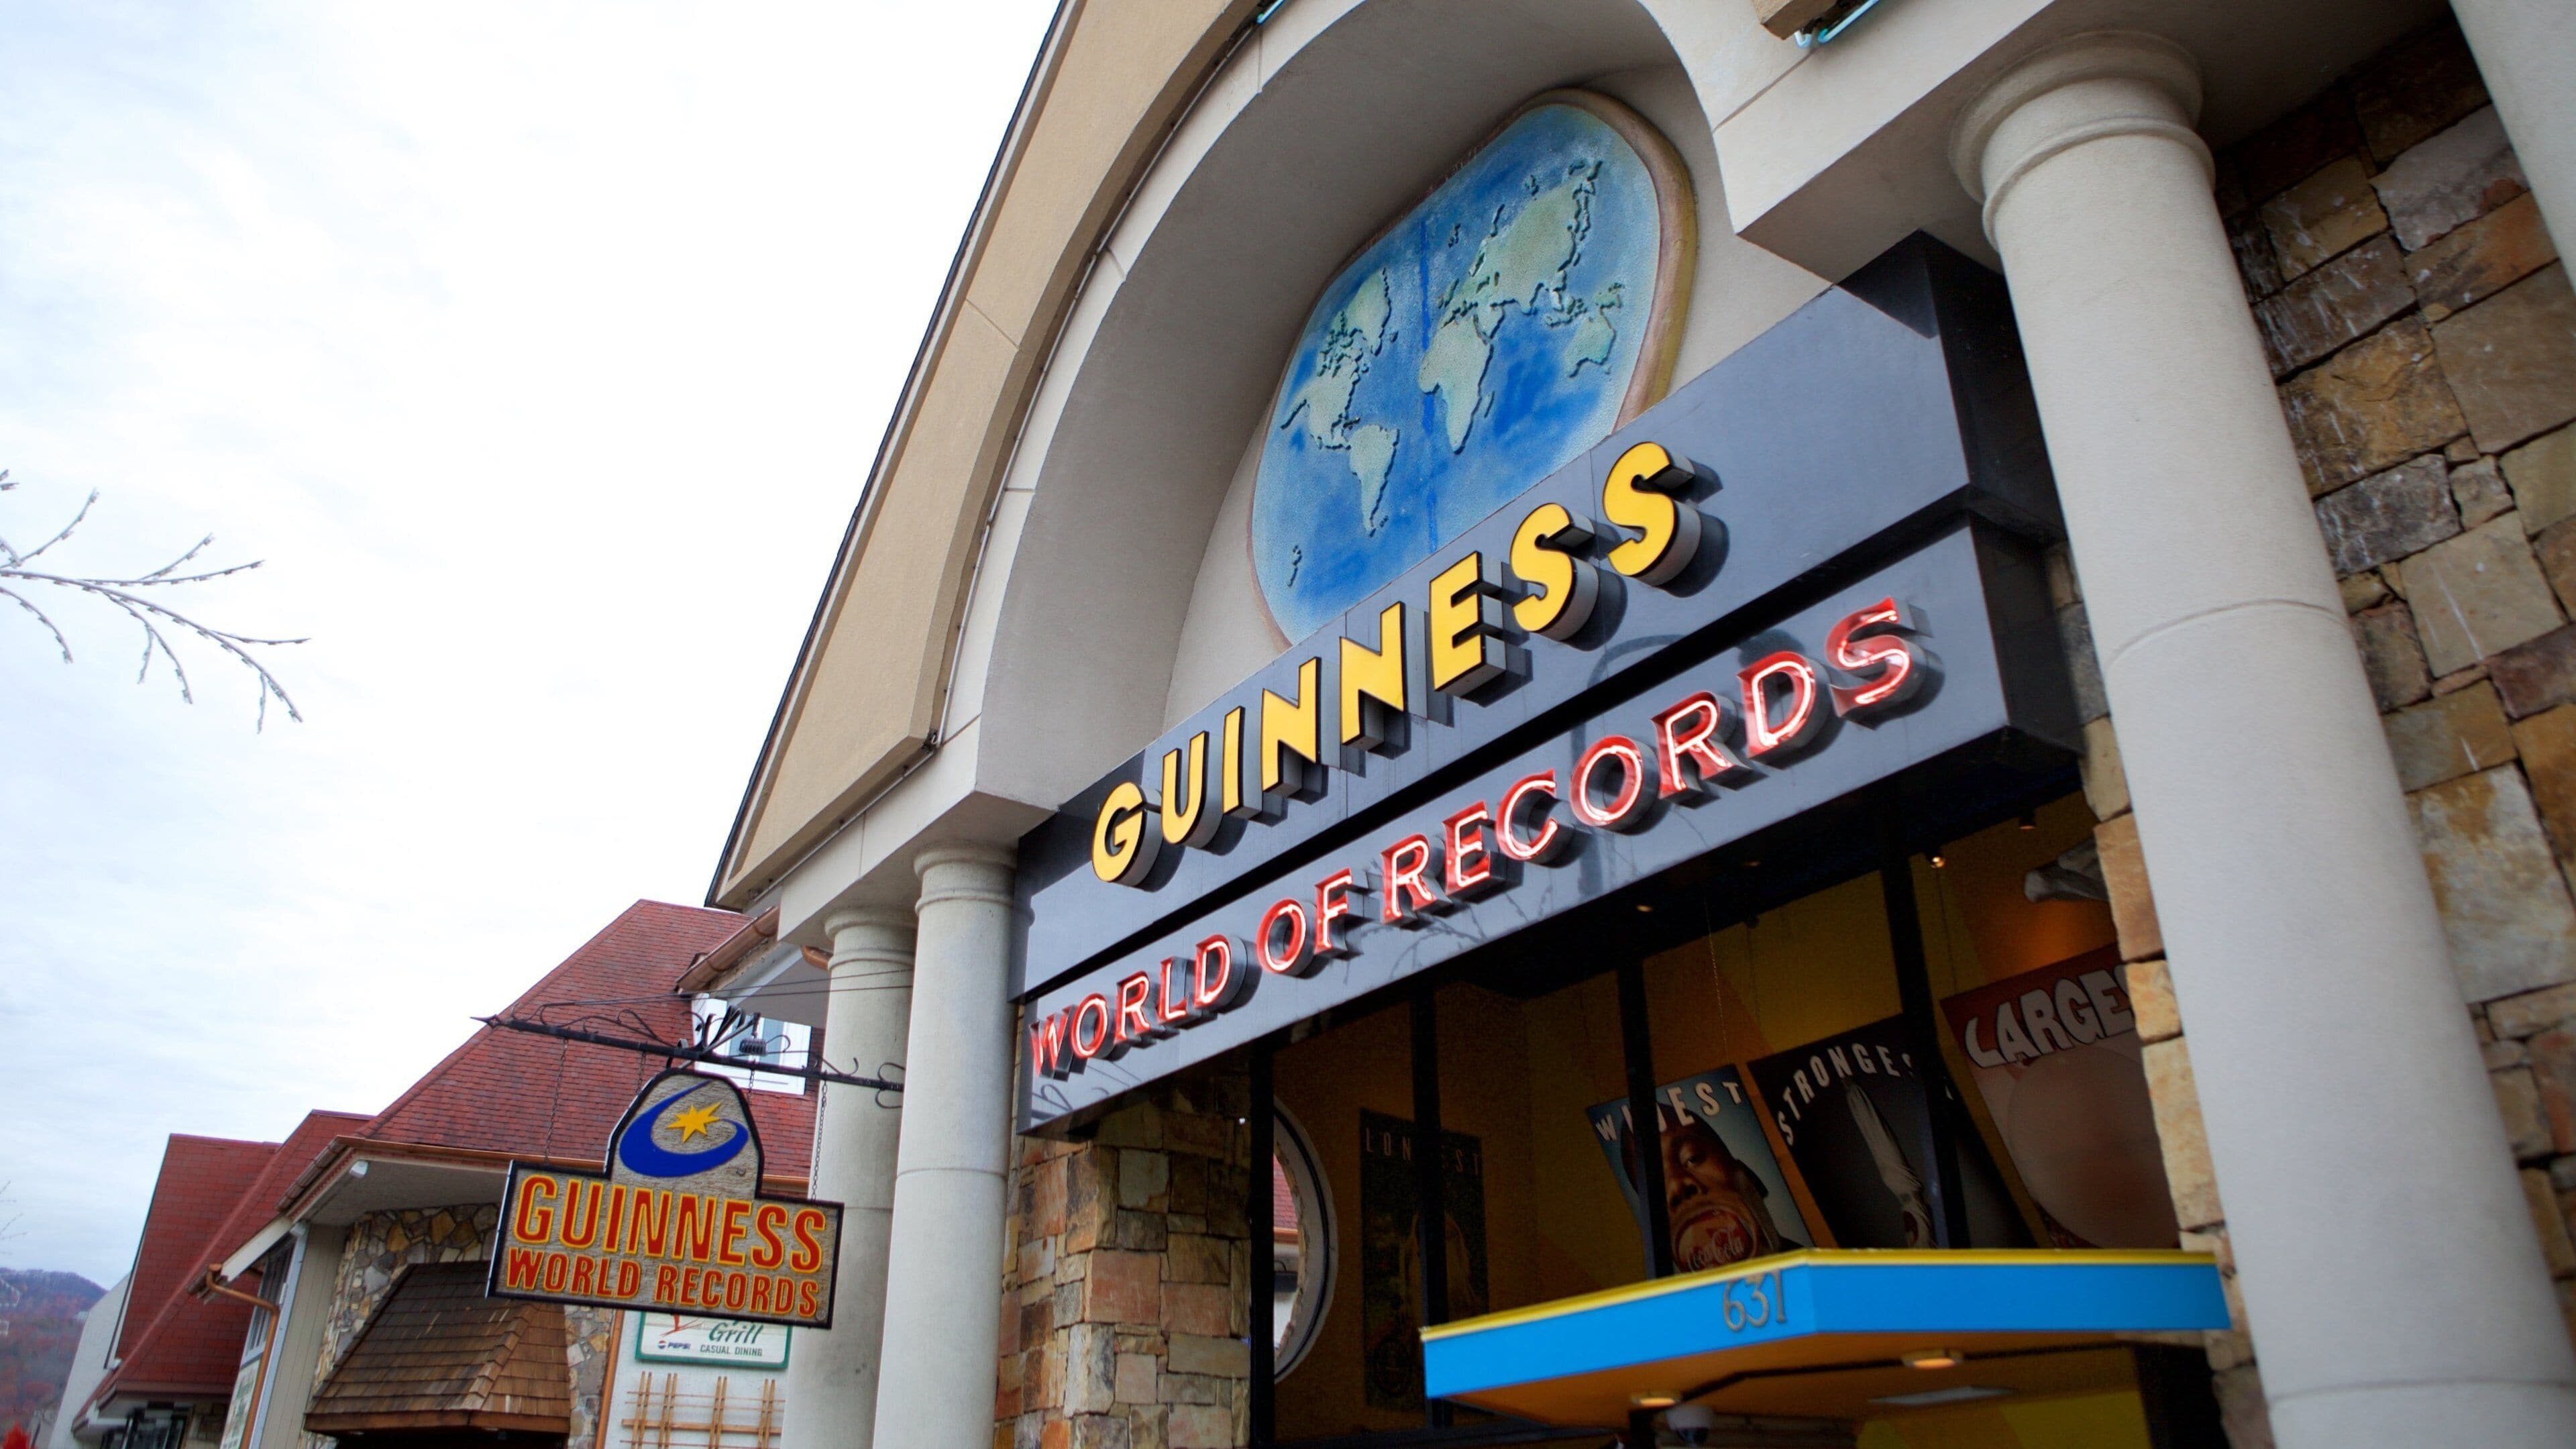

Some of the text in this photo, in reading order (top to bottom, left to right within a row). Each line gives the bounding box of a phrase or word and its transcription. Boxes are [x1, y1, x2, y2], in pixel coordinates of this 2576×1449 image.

[1092, 441, 1678, 884] GUINNESS
[1030, 597, 1915, 1077] WORLD OF RECORDS
[1964, 963, 2137, 1069] LARGE
[1777, 1042, 1953, 1148] STRONGE
[1366, 1126, 1482, 1176] LONST
[513, 1174, 826, 1274] GUINNESS
[506, 1246, 819, 1318] WORLD RECORDS
[1722, 1269, 1787, 1332] 631
[667, 1342, 691, 1350] PEPSI
[700, 1344, 763, 1356] CASUAL DINING
[708, 1322, 765, 1344] Grill
